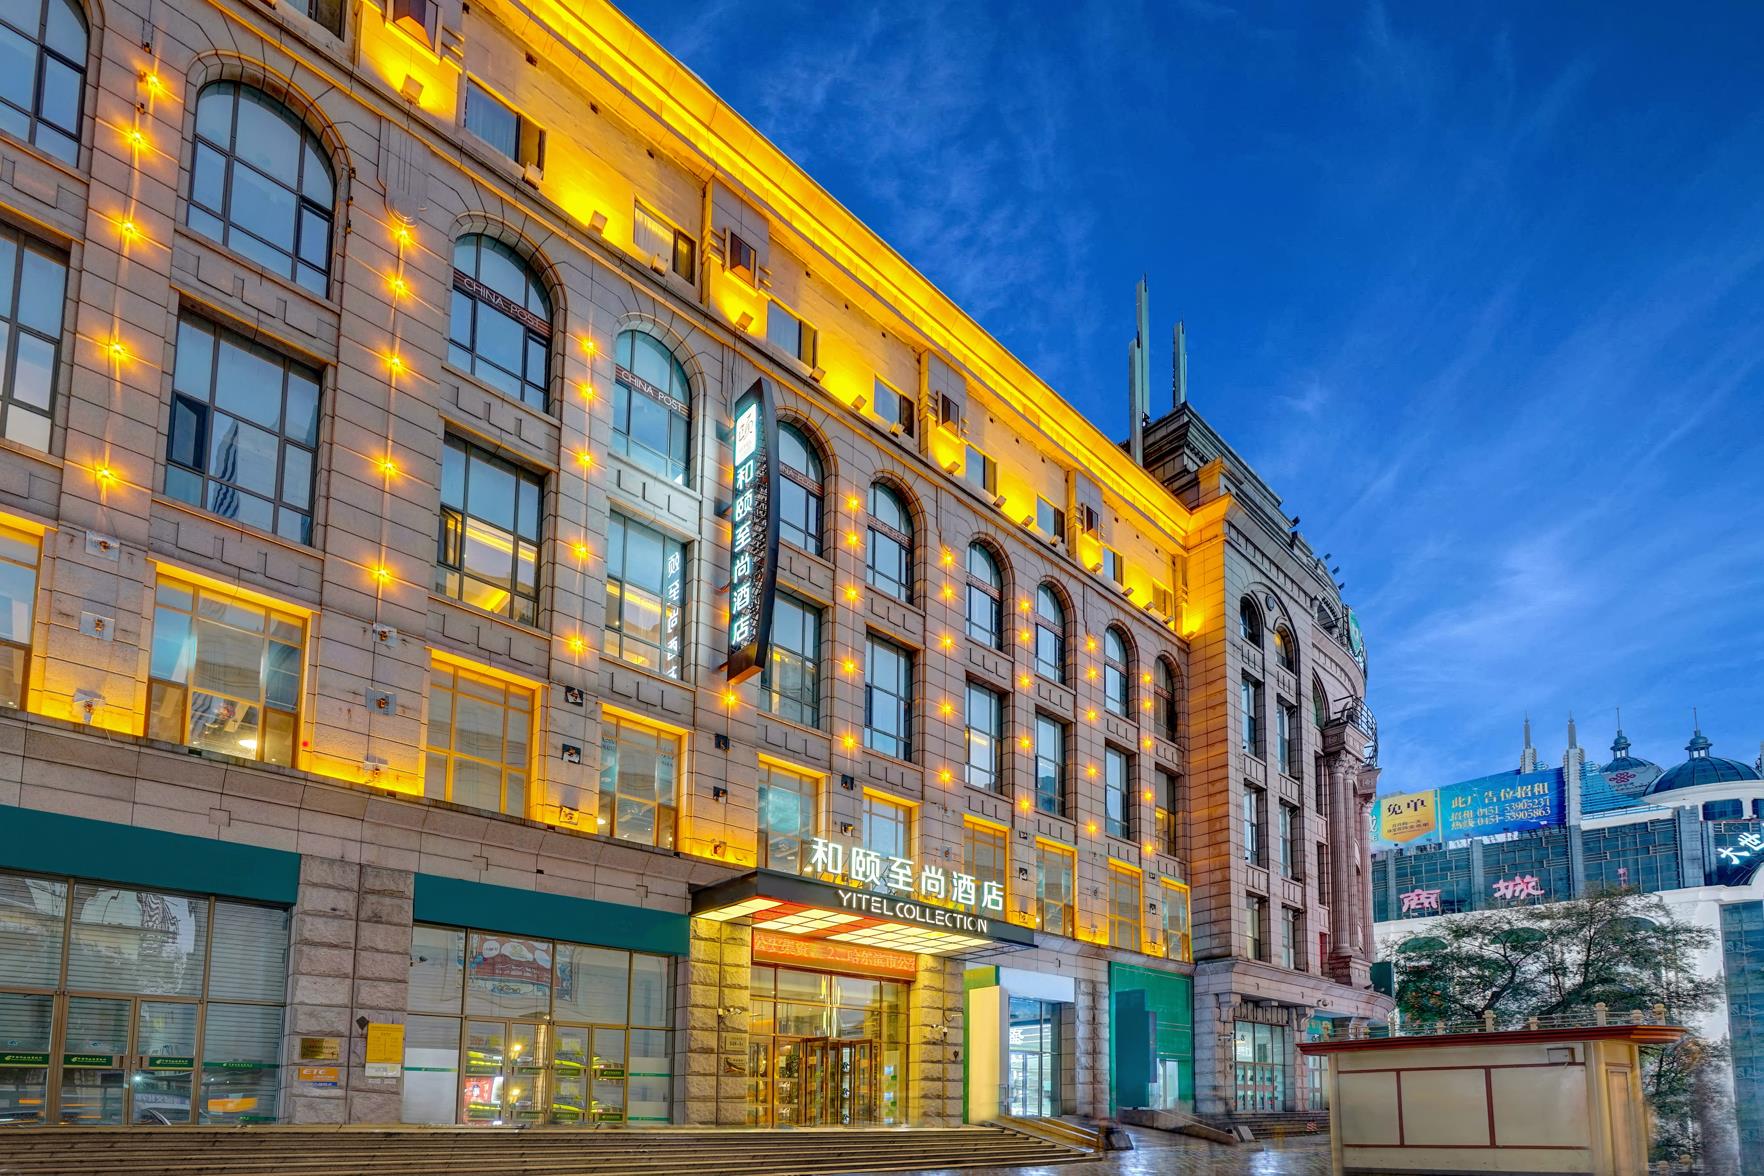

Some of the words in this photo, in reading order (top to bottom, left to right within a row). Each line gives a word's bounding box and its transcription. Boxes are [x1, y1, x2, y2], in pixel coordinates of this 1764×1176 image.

[463, 278, 508, 310] CHINA
[510, 304, 541, 328] POST
[621, 370, 654, 396] CHINA
[658, 391, 684, 412] POST
[733, 459, 755, 646] 和颐至尚酒店
[1451, 782, 1550, 809] 此广告位招租
[811, 837, 1005, 911] 和颐至尚酒店
[838, 889, 894, 917] YITEL
[895, 902, 988, 934] COLLECTION
